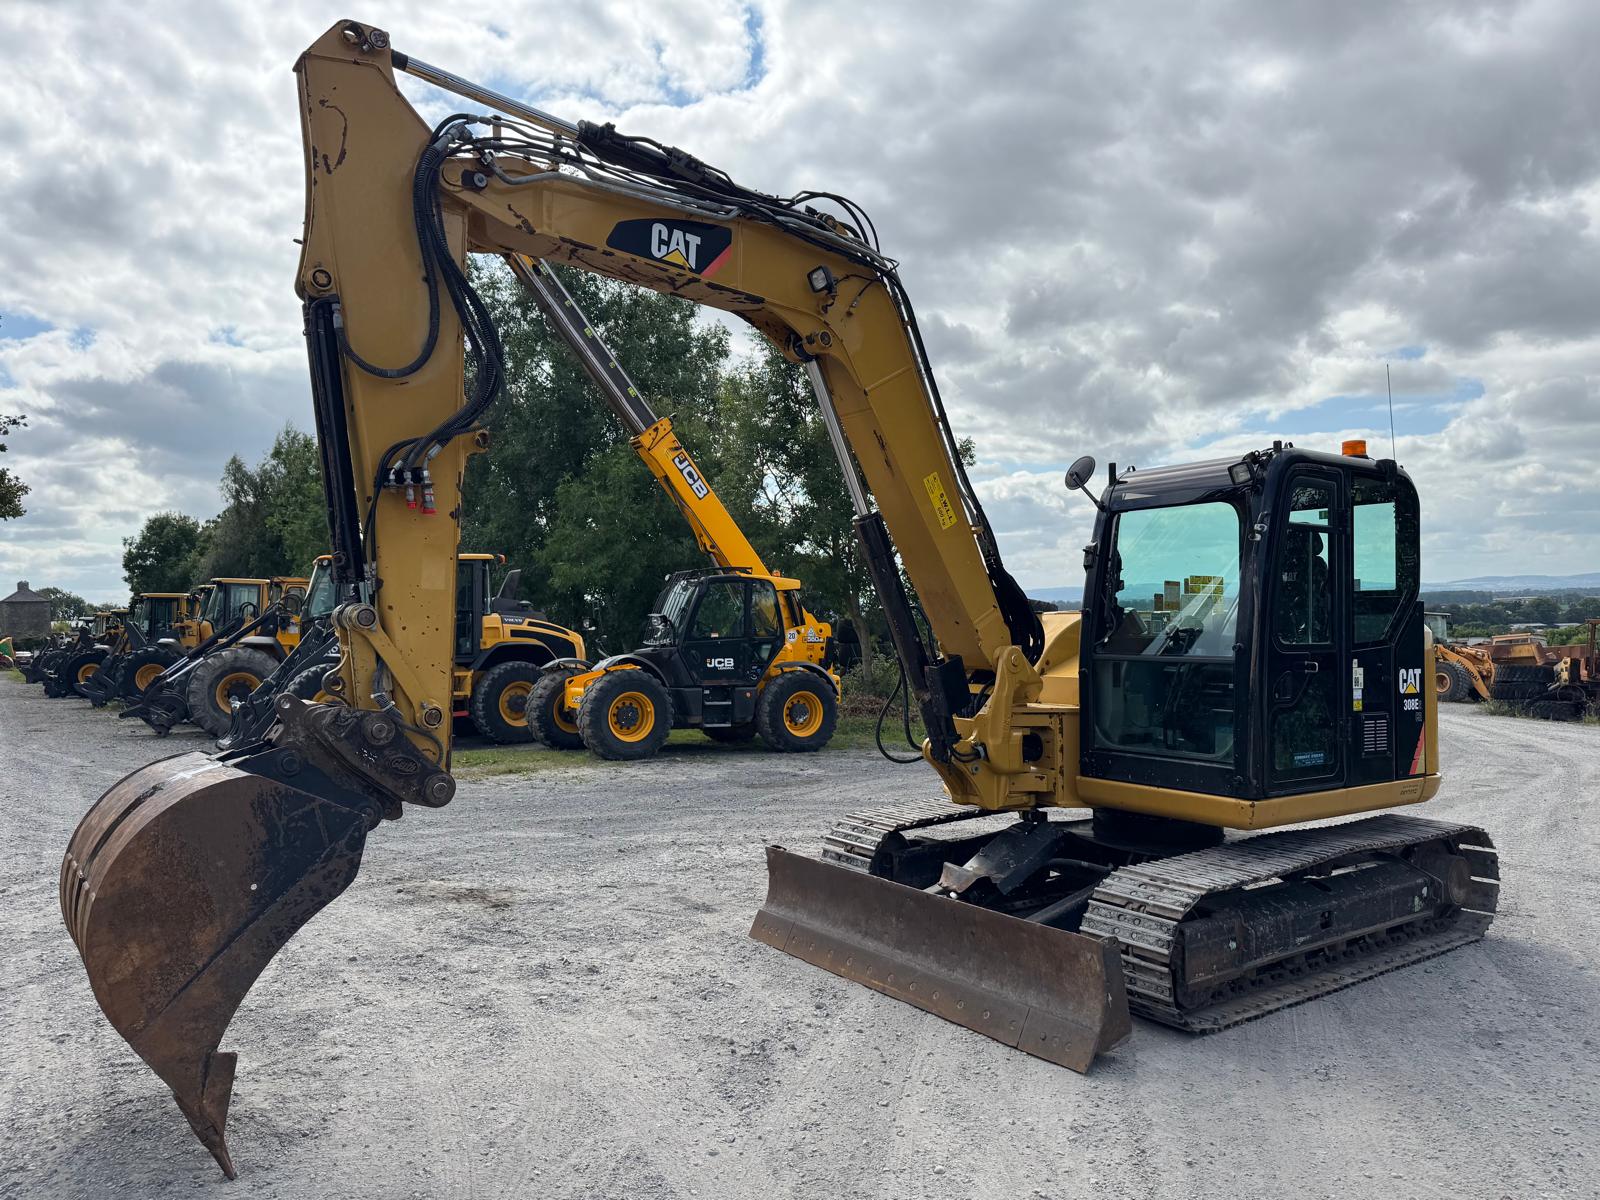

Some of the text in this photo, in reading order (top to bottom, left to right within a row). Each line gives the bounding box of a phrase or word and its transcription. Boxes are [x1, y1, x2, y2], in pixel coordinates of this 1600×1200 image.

[651, 222, 701, 270] CAT
[673, 452, 709, 499] JCB
[788, 632, 796, 640] 20
[706, 657, 735, 668] JCB
[1456, 658, 1480, 682] HYUNDAI
[1399, 668, 1422, 695] CAT
